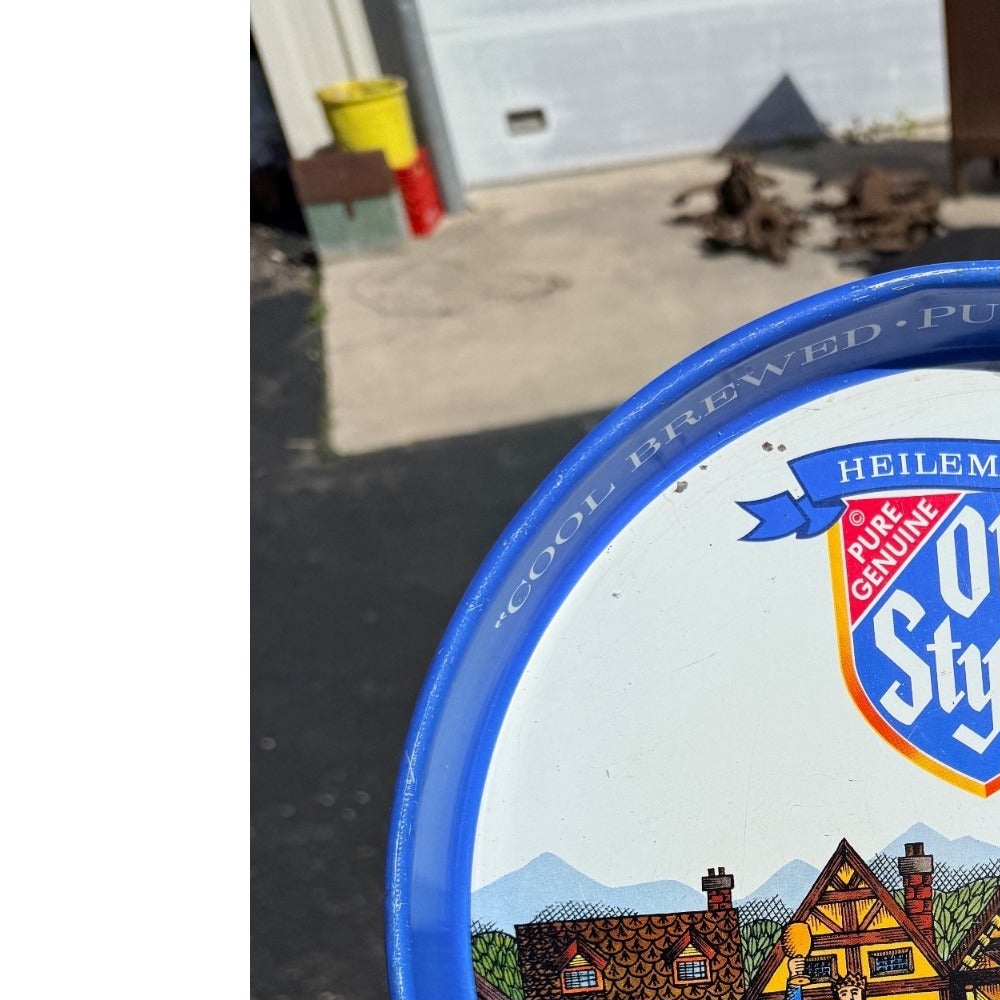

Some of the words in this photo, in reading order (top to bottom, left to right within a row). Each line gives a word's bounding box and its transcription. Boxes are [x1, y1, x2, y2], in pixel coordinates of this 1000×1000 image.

[625, 322, 882, 473] BREWED
[847, 500, 904, 565] PURE
[851, 497, 939, 601] GENUINE
